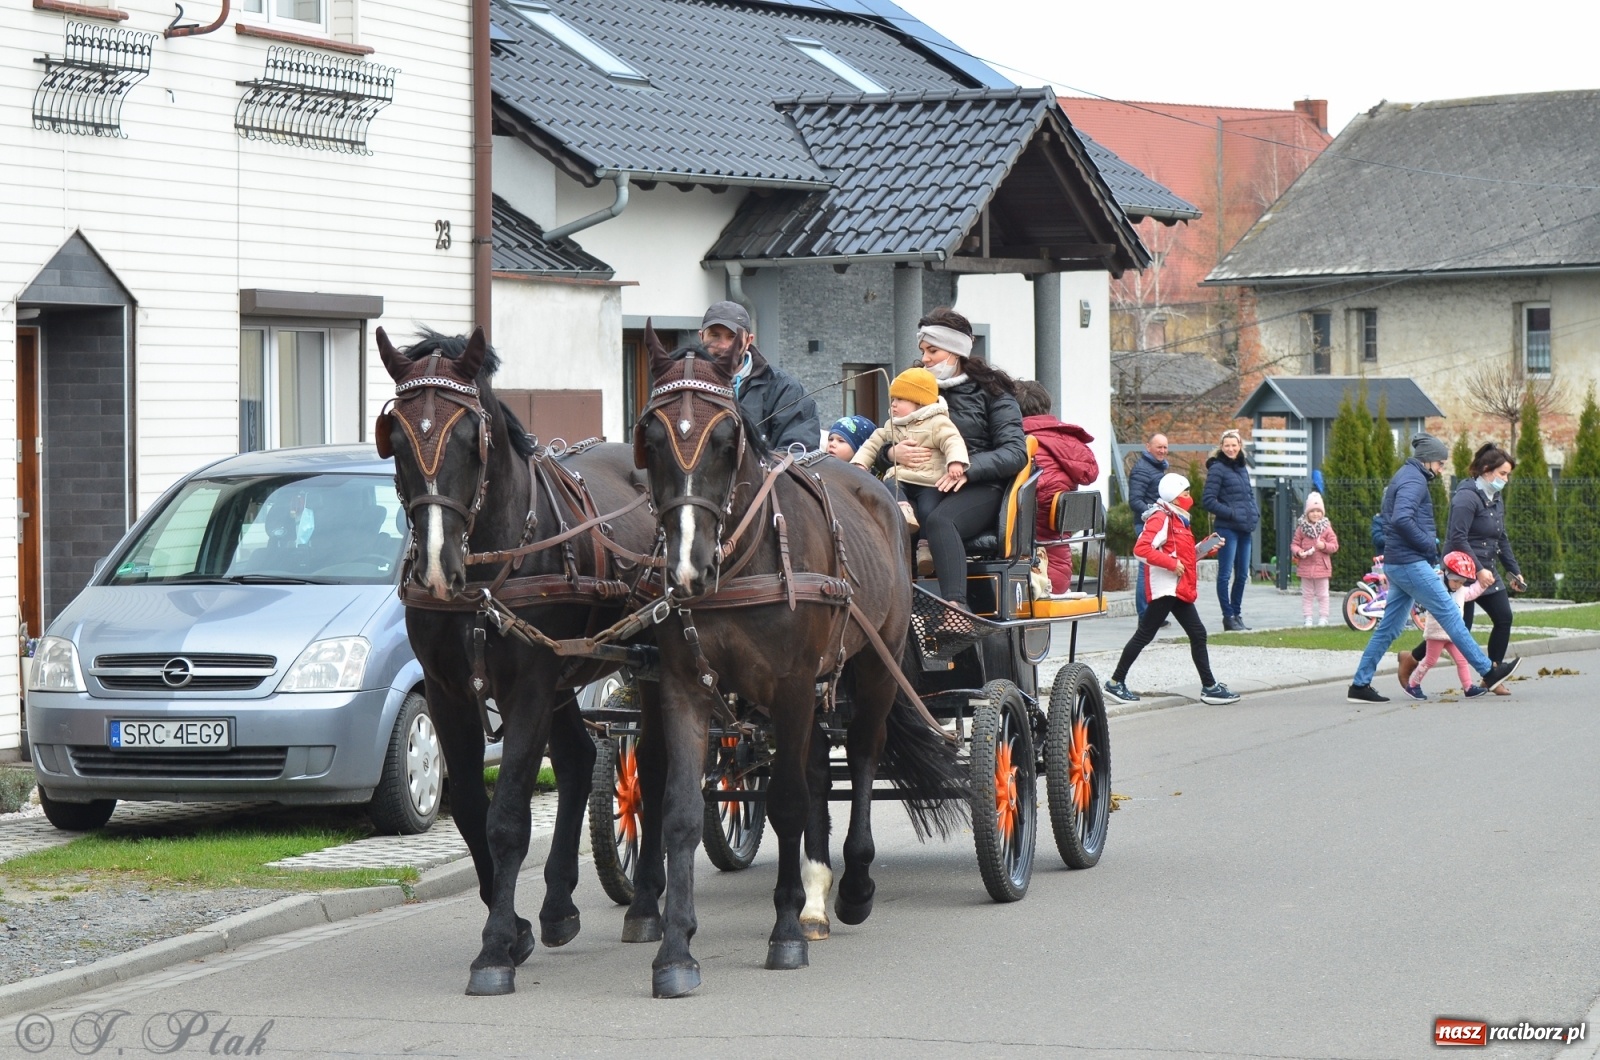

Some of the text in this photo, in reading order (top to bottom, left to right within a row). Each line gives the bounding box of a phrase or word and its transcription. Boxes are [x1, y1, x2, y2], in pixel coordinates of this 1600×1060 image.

[435, 219, 451, 250] 23
[124, 723, 224, 744] SRC 4EG9
